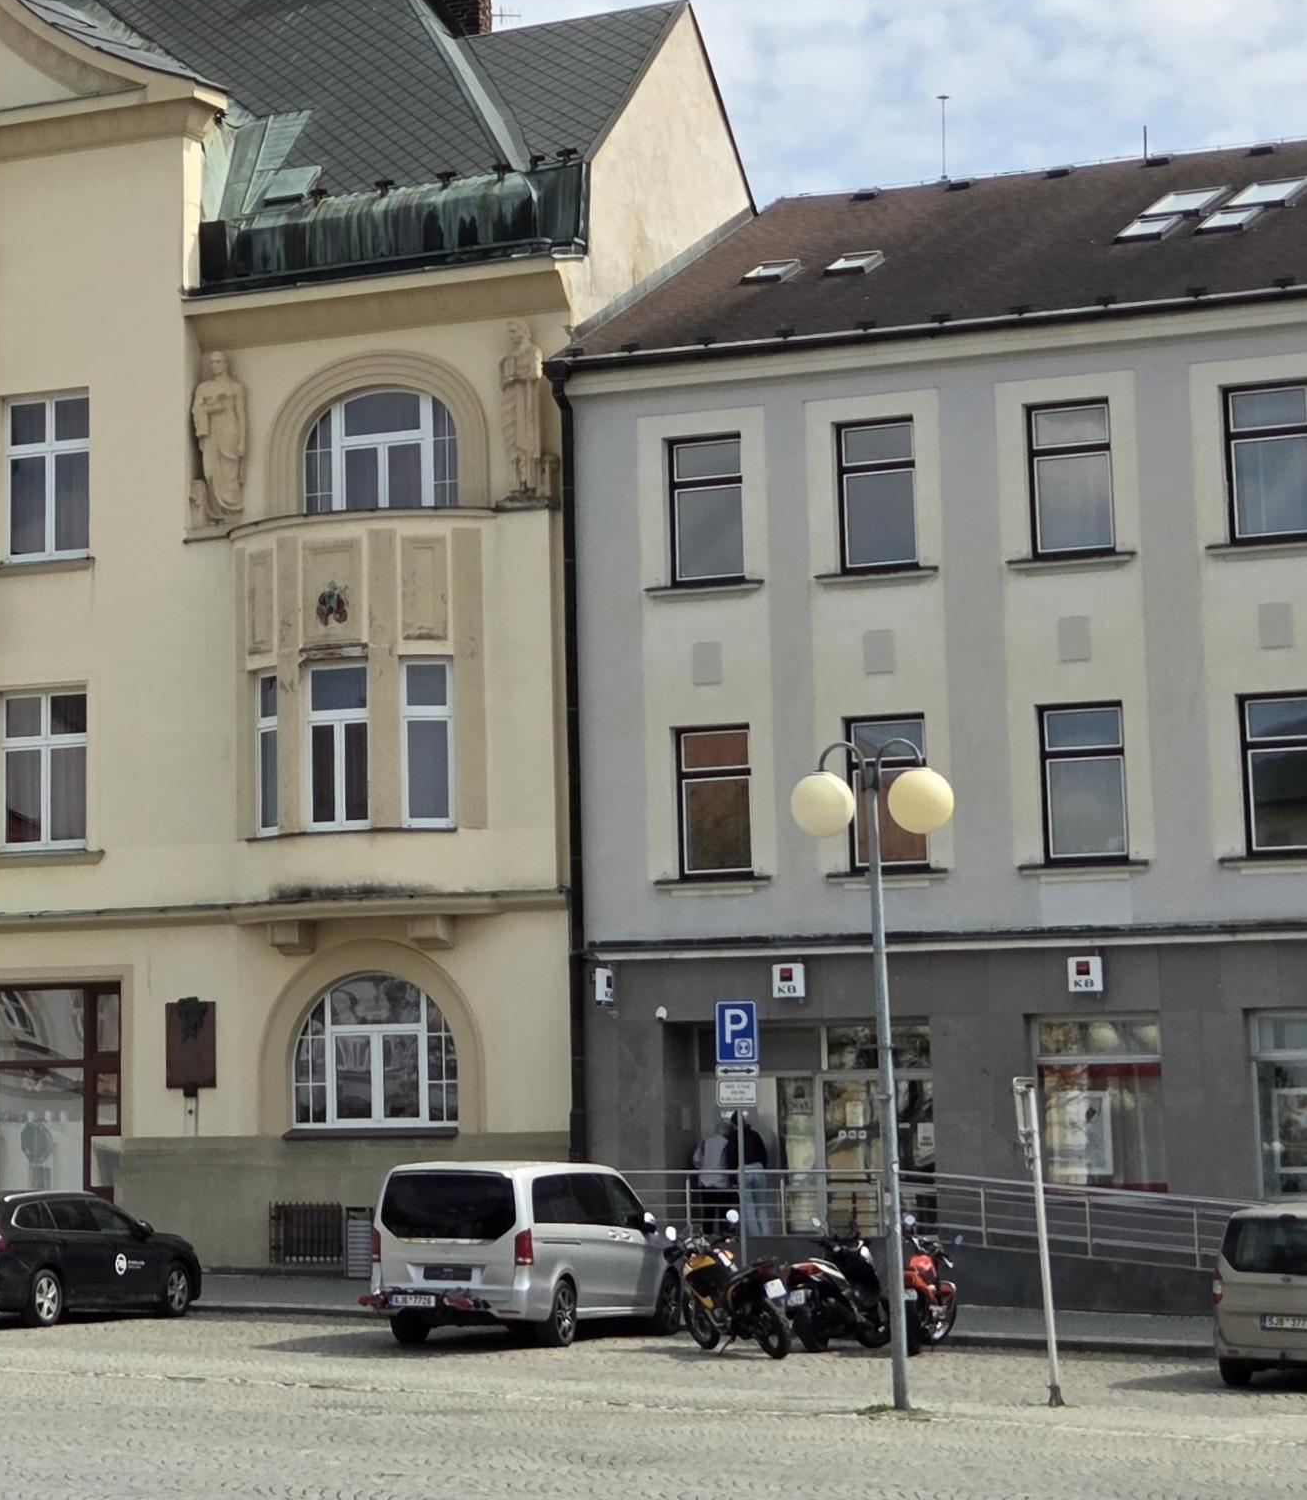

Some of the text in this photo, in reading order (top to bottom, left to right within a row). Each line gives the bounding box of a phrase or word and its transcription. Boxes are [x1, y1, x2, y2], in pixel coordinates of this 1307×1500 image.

[1074, 979, 1094, 988] KB
[778, 985, 796, 994] KB
[724, 1008, 748, 1044] P
